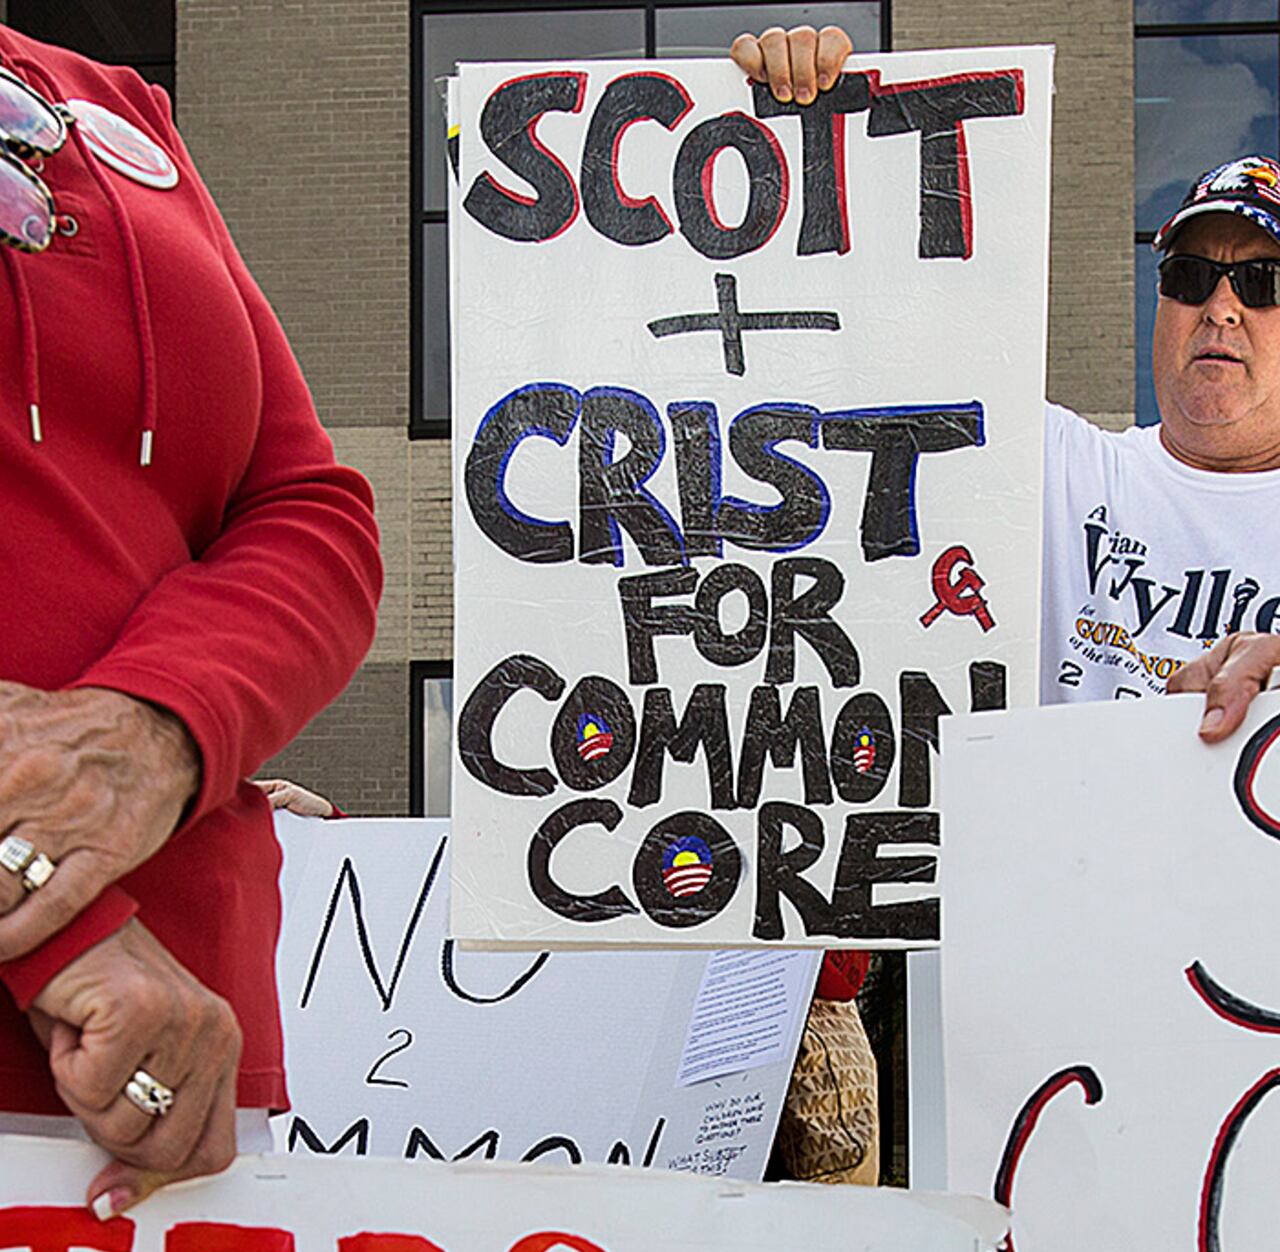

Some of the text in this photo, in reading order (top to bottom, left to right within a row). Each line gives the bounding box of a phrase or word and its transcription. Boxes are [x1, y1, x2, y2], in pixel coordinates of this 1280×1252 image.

[463, 69, 1025, 262] SCOTT
[464, 382, 984, 568] CRIST
[618, 556, 861, 689] FOR
[458, 653, 1007, 811] COMMON
[526, 798, 941, 941] CORE
[367, 1029, 412, 1087] 2
